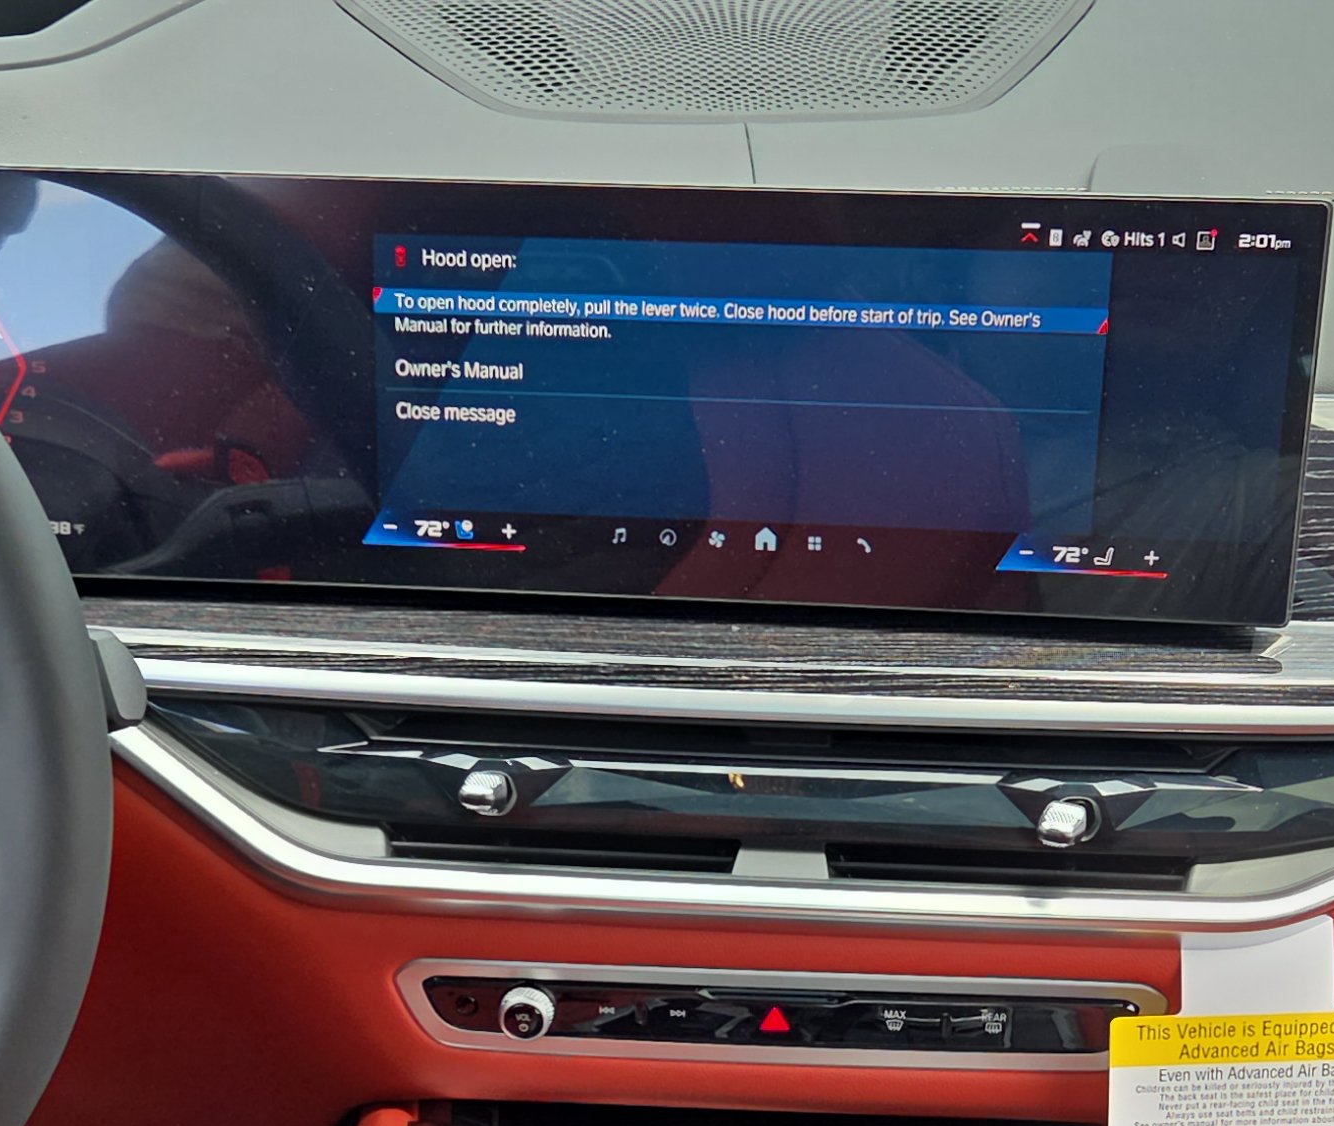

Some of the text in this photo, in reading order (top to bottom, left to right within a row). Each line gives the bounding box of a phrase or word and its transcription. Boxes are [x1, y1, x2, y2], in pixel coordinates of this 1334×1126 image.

[1124, 231, 1166, 247] Hits 1
[422, 248, 517, 271] Hood open:
[395, 293, 1041, 329] To open hood completely, pull the lever twice. Close hood before start of trip. See Owner's
[395, 316, 611, 339] Manual for further information.
[32, 361, 46, 373] 5
[395, 358, 523, 380] Owner's Manual
[21, 386, 36, 399] 4
[10, 410, 24, 423] 3
[395, 401, 516, 427] Close message
[515, 1013, 533, 1022] VOL
[884, 1010, 908, 1019] MAX
[981, 1012, 1007, 1022] REAR
[1137, 1024, 1170, 1040] This
[1177, 1021, 1236, 1039] Vehicle
[1243, 1021, 1255, 1037] is
[1179, 1039, 1334, 1059] Advanced Air Bags
[1159, 1068, 1190, 1082] Even
[1195, 1067, 1223, 1081] with
[1227, 1064, 1293, 1080] Advanced
[1297, 1063, 1317, 1077] Air
[1136, 1085, 1170, 1094] Children
[1191, 1083, 1201, 1091] be
[1242, 1080, 1280, 1090] seriously
[1283, 1080, 1312, 1089] injured
[1315, 1080, 1325, 1090] by
[1159, 1094, 1174, 1102] The
[1178, 1093, 1196, 1101] back
[1200, 1092, 1217, 1100] seat
[1230, 1091, 1243, 1099] the
[1247, 1090, 1272, 1099] safest
[1274, 1090, 1296, 1099] place
[1299, 1089, 1312, 1097] for
[1158, 1102, 1182, 1111] Never
[1185, 1101, 1199, 1111] put
[1209, 1099, 1255, 1109] rear-facing
[1258, 1098, 1279, 1107] child
[1282, 1098, 1299, 1106] seat
[1302, 1098, 1310, 1106] in
[1166, 1111, 1195, 1120] Always
[1198, 1111, 1212, 1119] use
[1216, 1110, 1233, 1118] seat
[1236, 1109, 1256, 1117] belts
[1259, 1108, 1274, 1116] and
[1277, 1107, 1298, 1115] child
[1220, 1118, 1233, 1126] for
[1235, 1118, 1257, 1126] more
[1260, 1116, 1308, 1125] information
